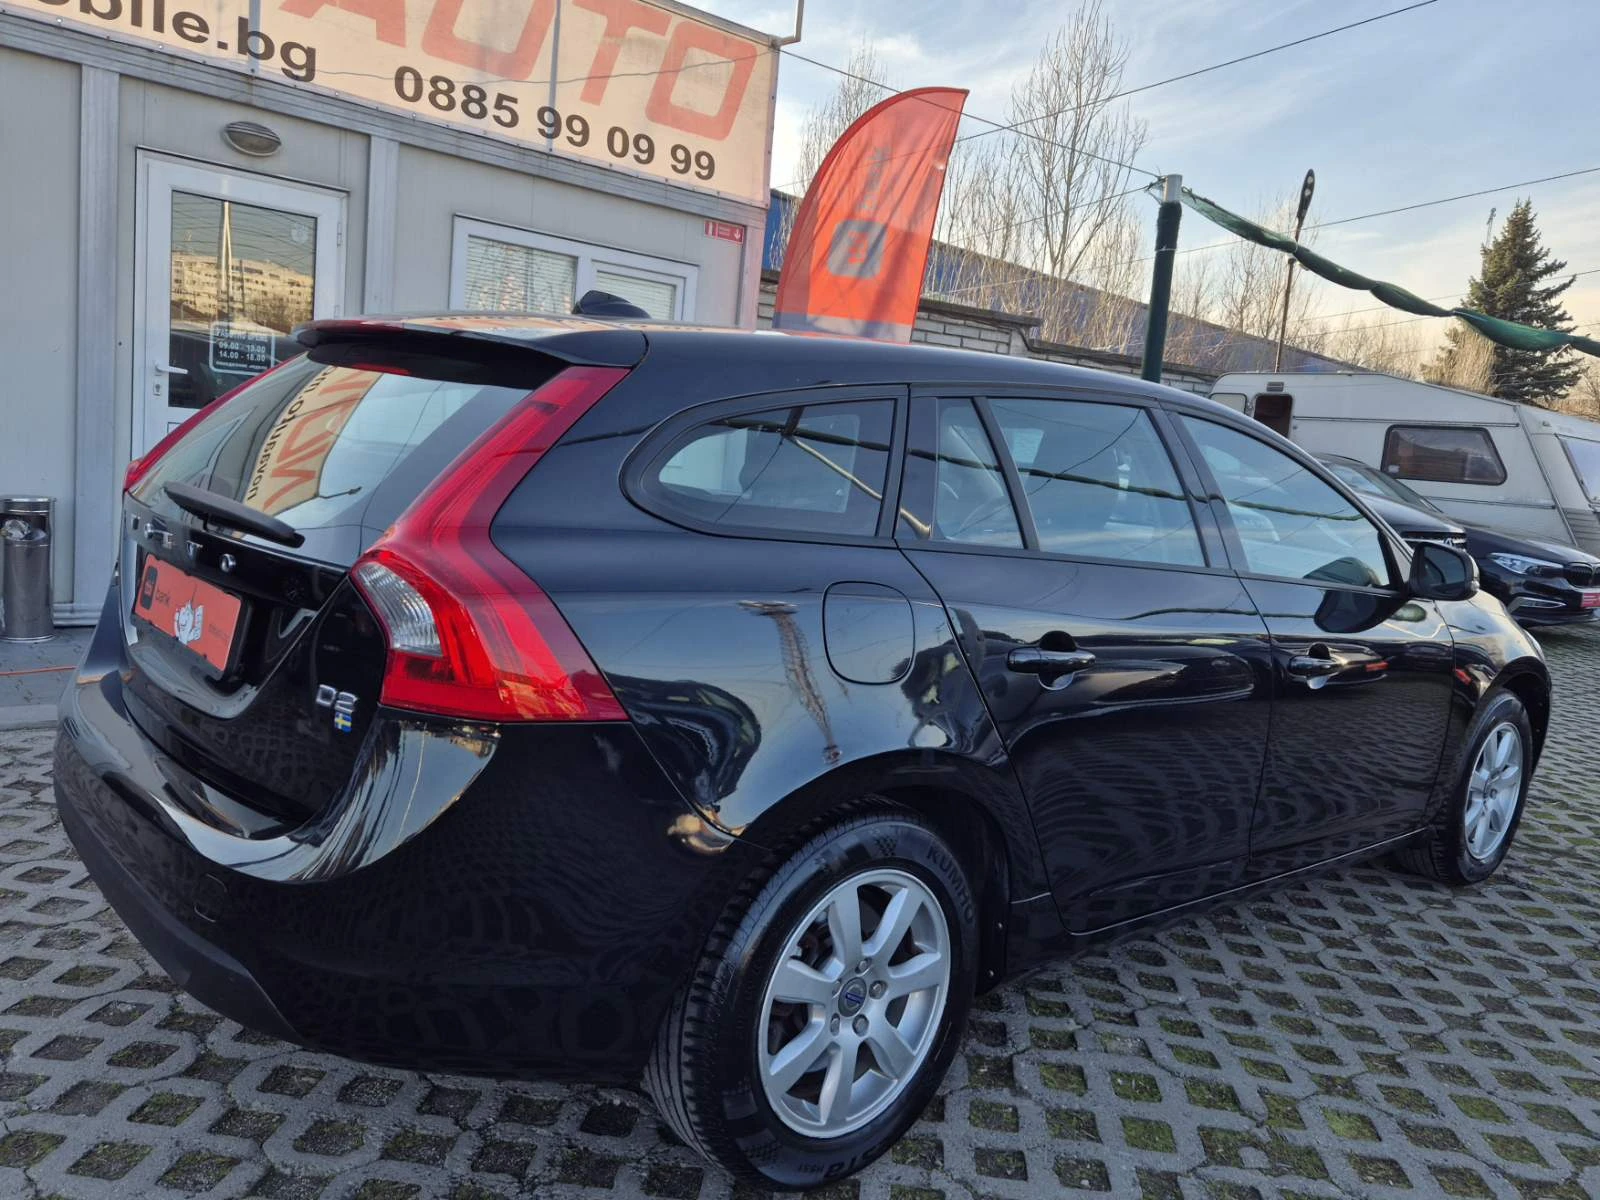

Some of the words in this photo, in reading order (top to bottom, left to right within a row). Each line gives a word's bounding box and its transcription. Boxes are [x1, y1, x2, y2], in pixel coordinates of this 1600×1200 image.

[394, 65, 520, 129] 0885
[536, 105, 591, 148] 99
[606, 125, 656, 166] 09
[669, 143, 716, 181] 99
[218, 350, 240, 360] 14.00
